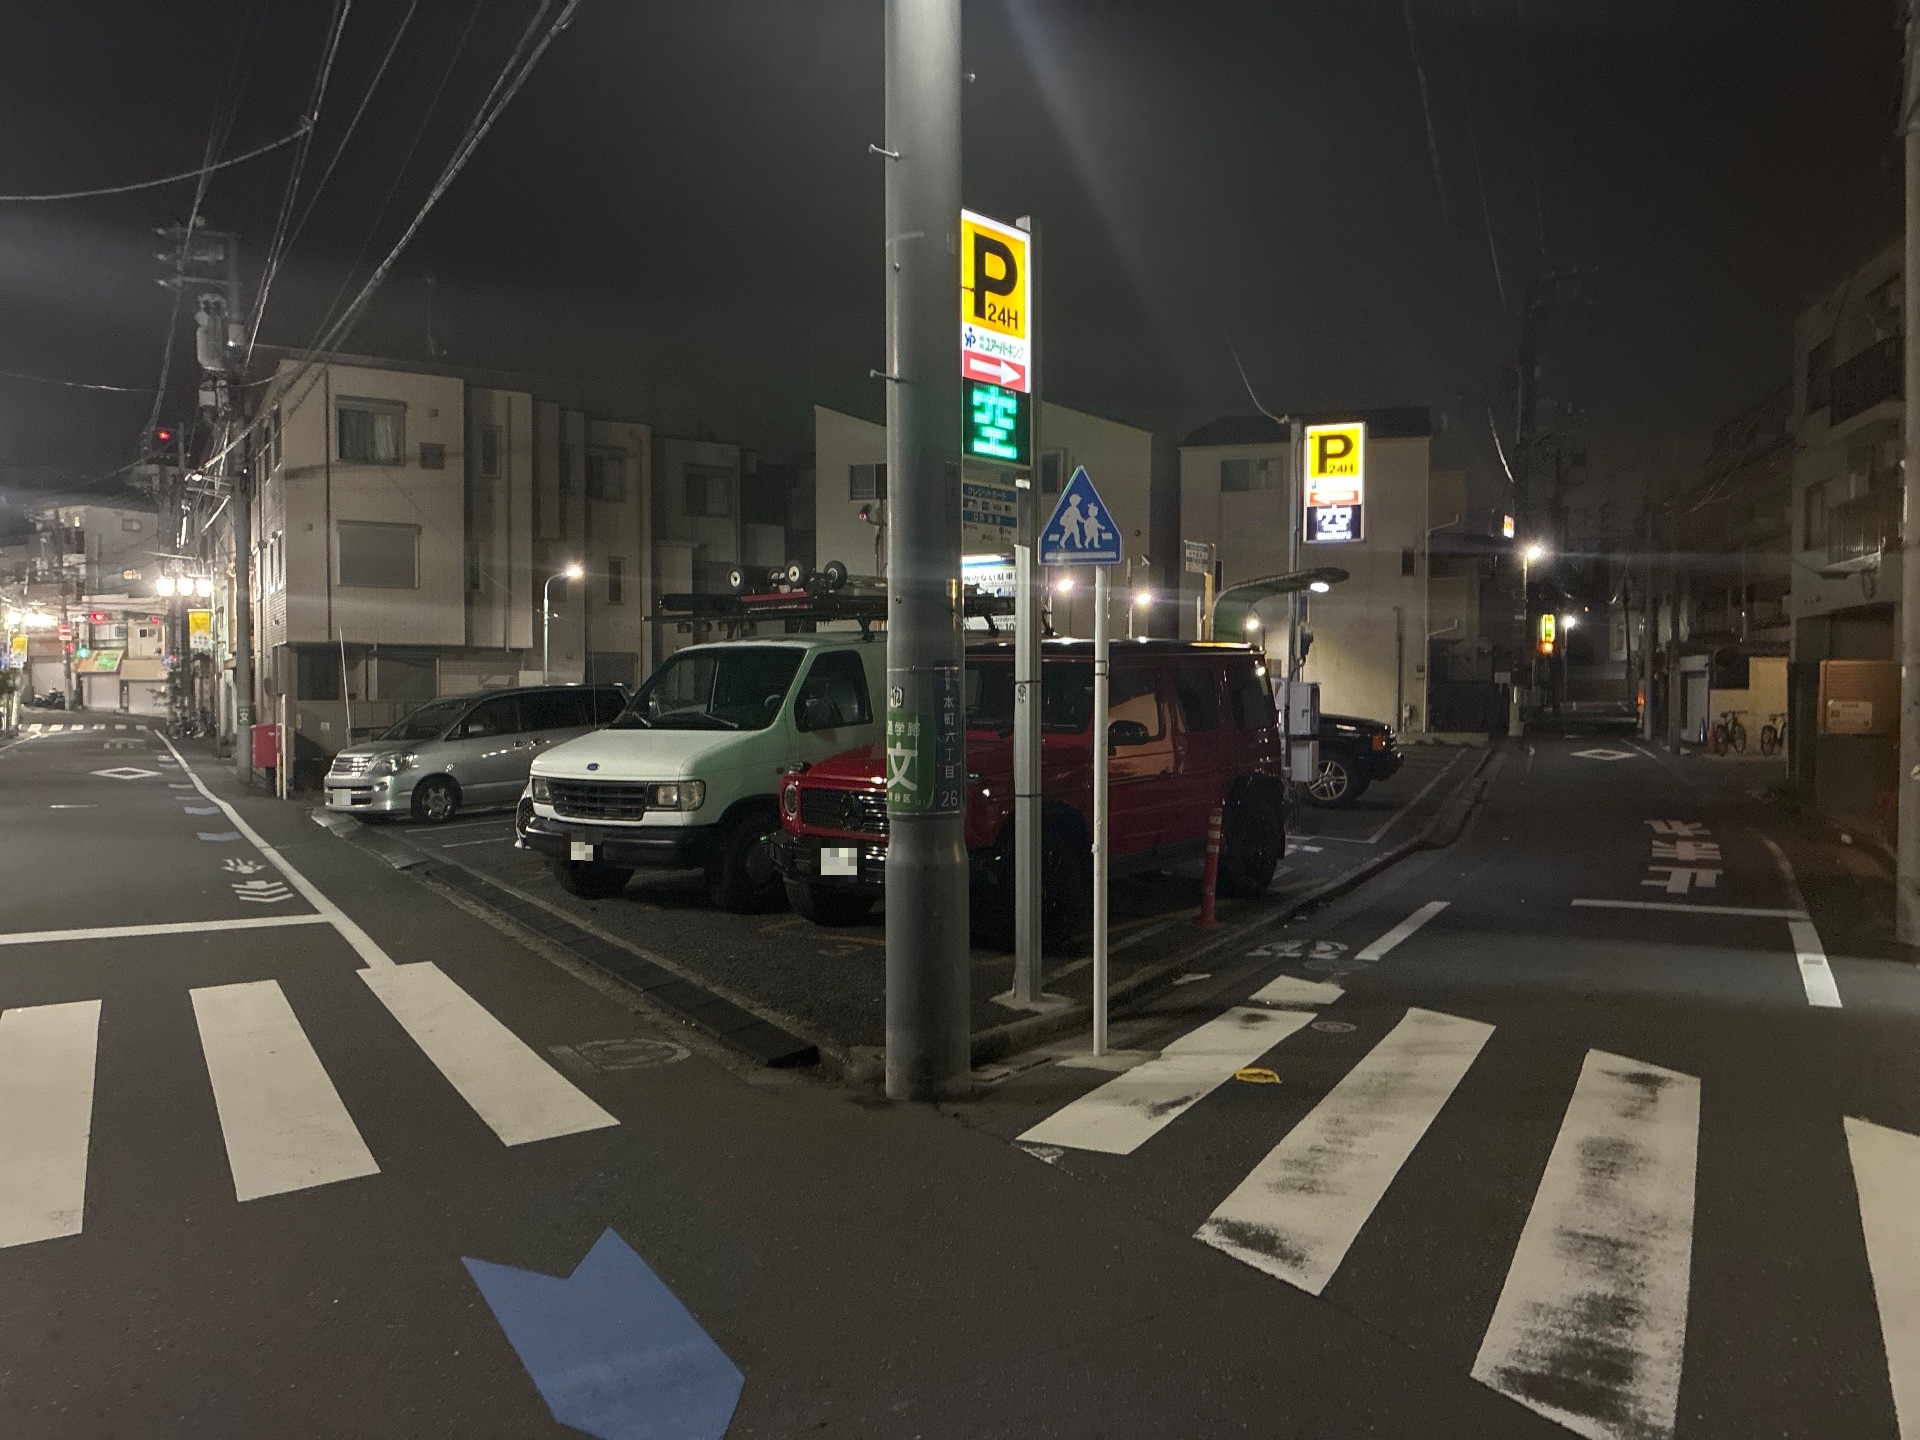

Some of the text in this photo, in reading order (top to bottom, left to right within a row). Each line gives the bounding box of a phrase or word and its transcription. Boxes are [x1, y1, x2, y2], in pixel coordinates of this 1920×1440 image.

[974, 230, 1018, 319] P
[987, 303, 1018, 330] 24H
[972, 384, 1017, 460] 空
[1318, 434, 1353, 474] P
[1329, 464, 1353, 474] 24H
[943, 695, 956, 779] 本町六丁目
[887, 742, 918, 791] 文
[941, 790, 958, 807] 26
